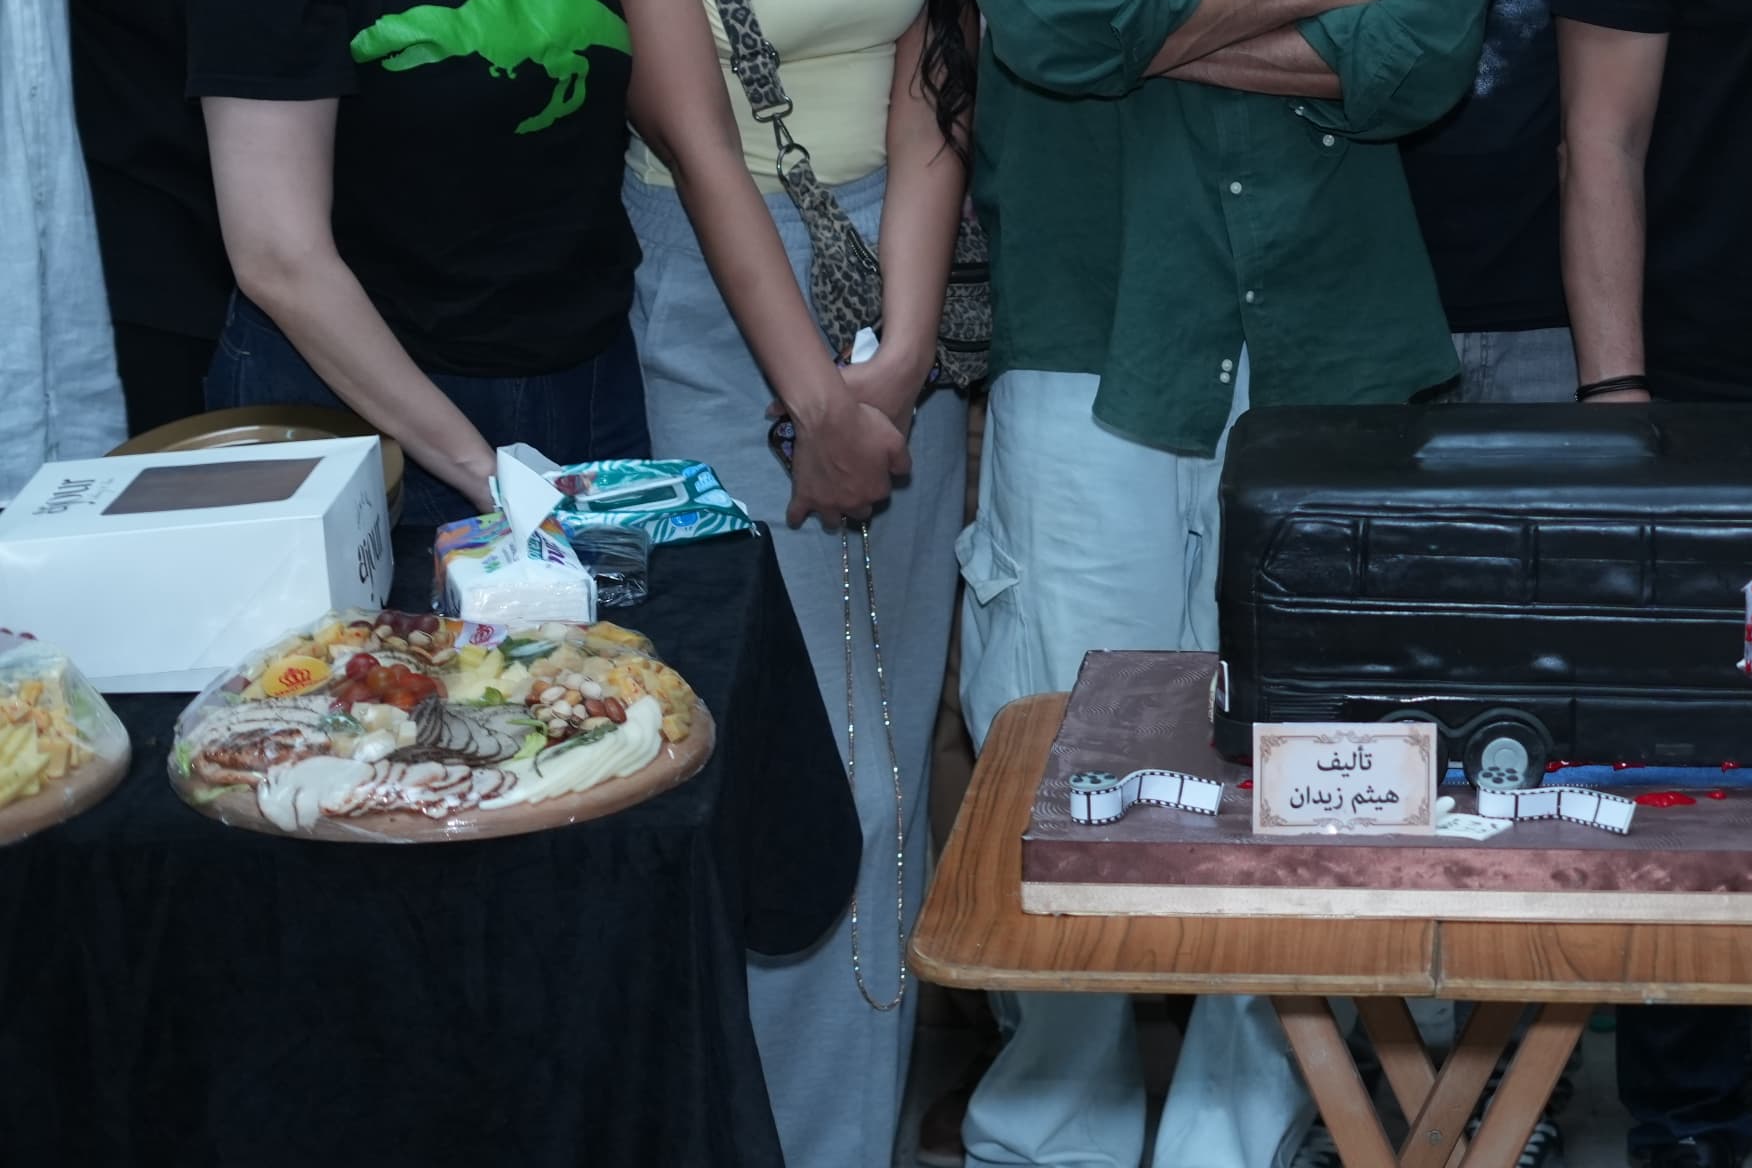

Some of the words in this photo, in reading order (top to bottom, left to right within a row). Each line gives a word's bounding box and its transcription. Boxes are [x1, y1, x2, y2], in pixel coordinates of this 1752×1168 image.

[1316, 745, 1373, 778] تأليف
[1289, 785, 1344, 812] زيدان
[1350, 785, 1401, 814] هيثم
